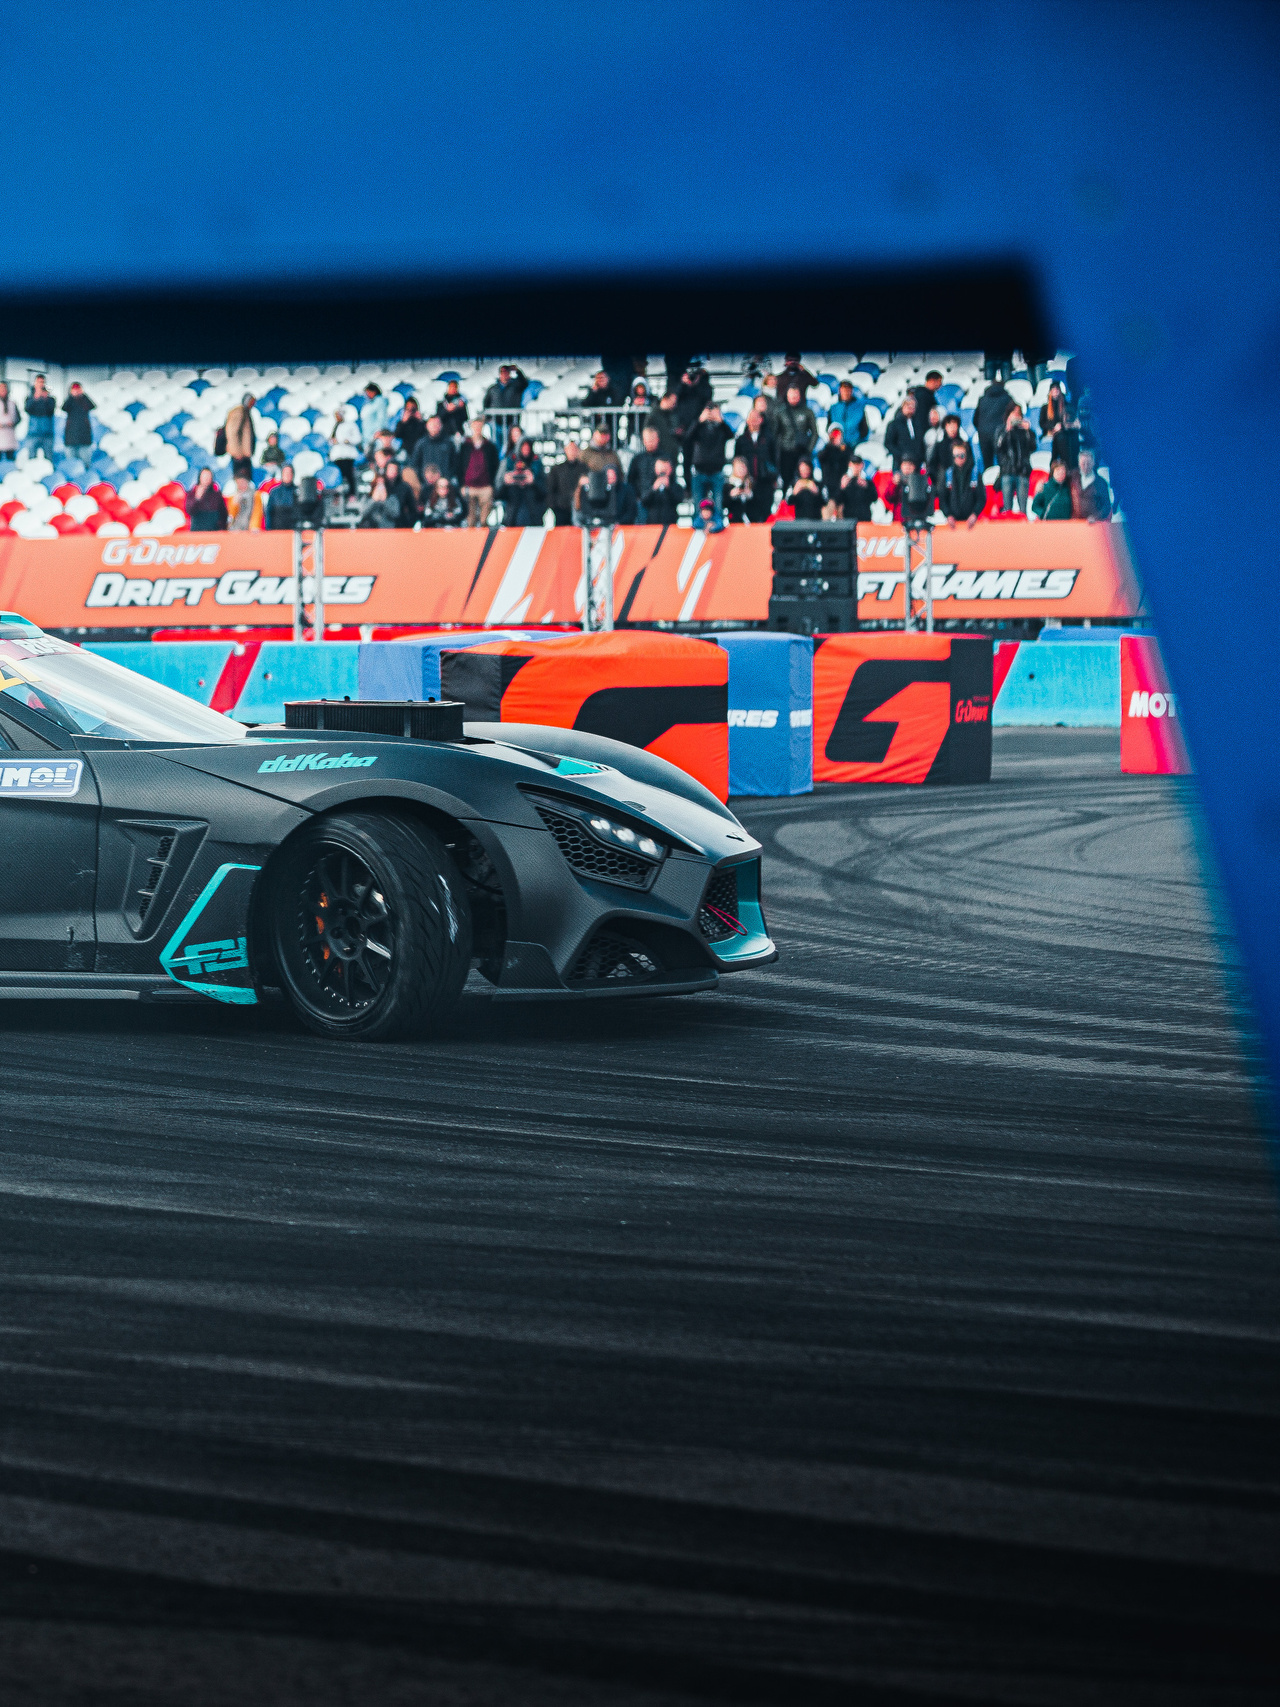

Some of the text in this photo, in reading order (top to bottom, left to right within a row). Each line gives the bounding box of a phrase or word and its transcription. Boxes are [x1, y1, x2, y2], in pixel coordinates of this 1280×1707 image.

[85, 570, 377, 607] DRIFT GAMES
[910, 563, 1082, 601] GAMES
[257, 752, 379, 774] ddKaba
